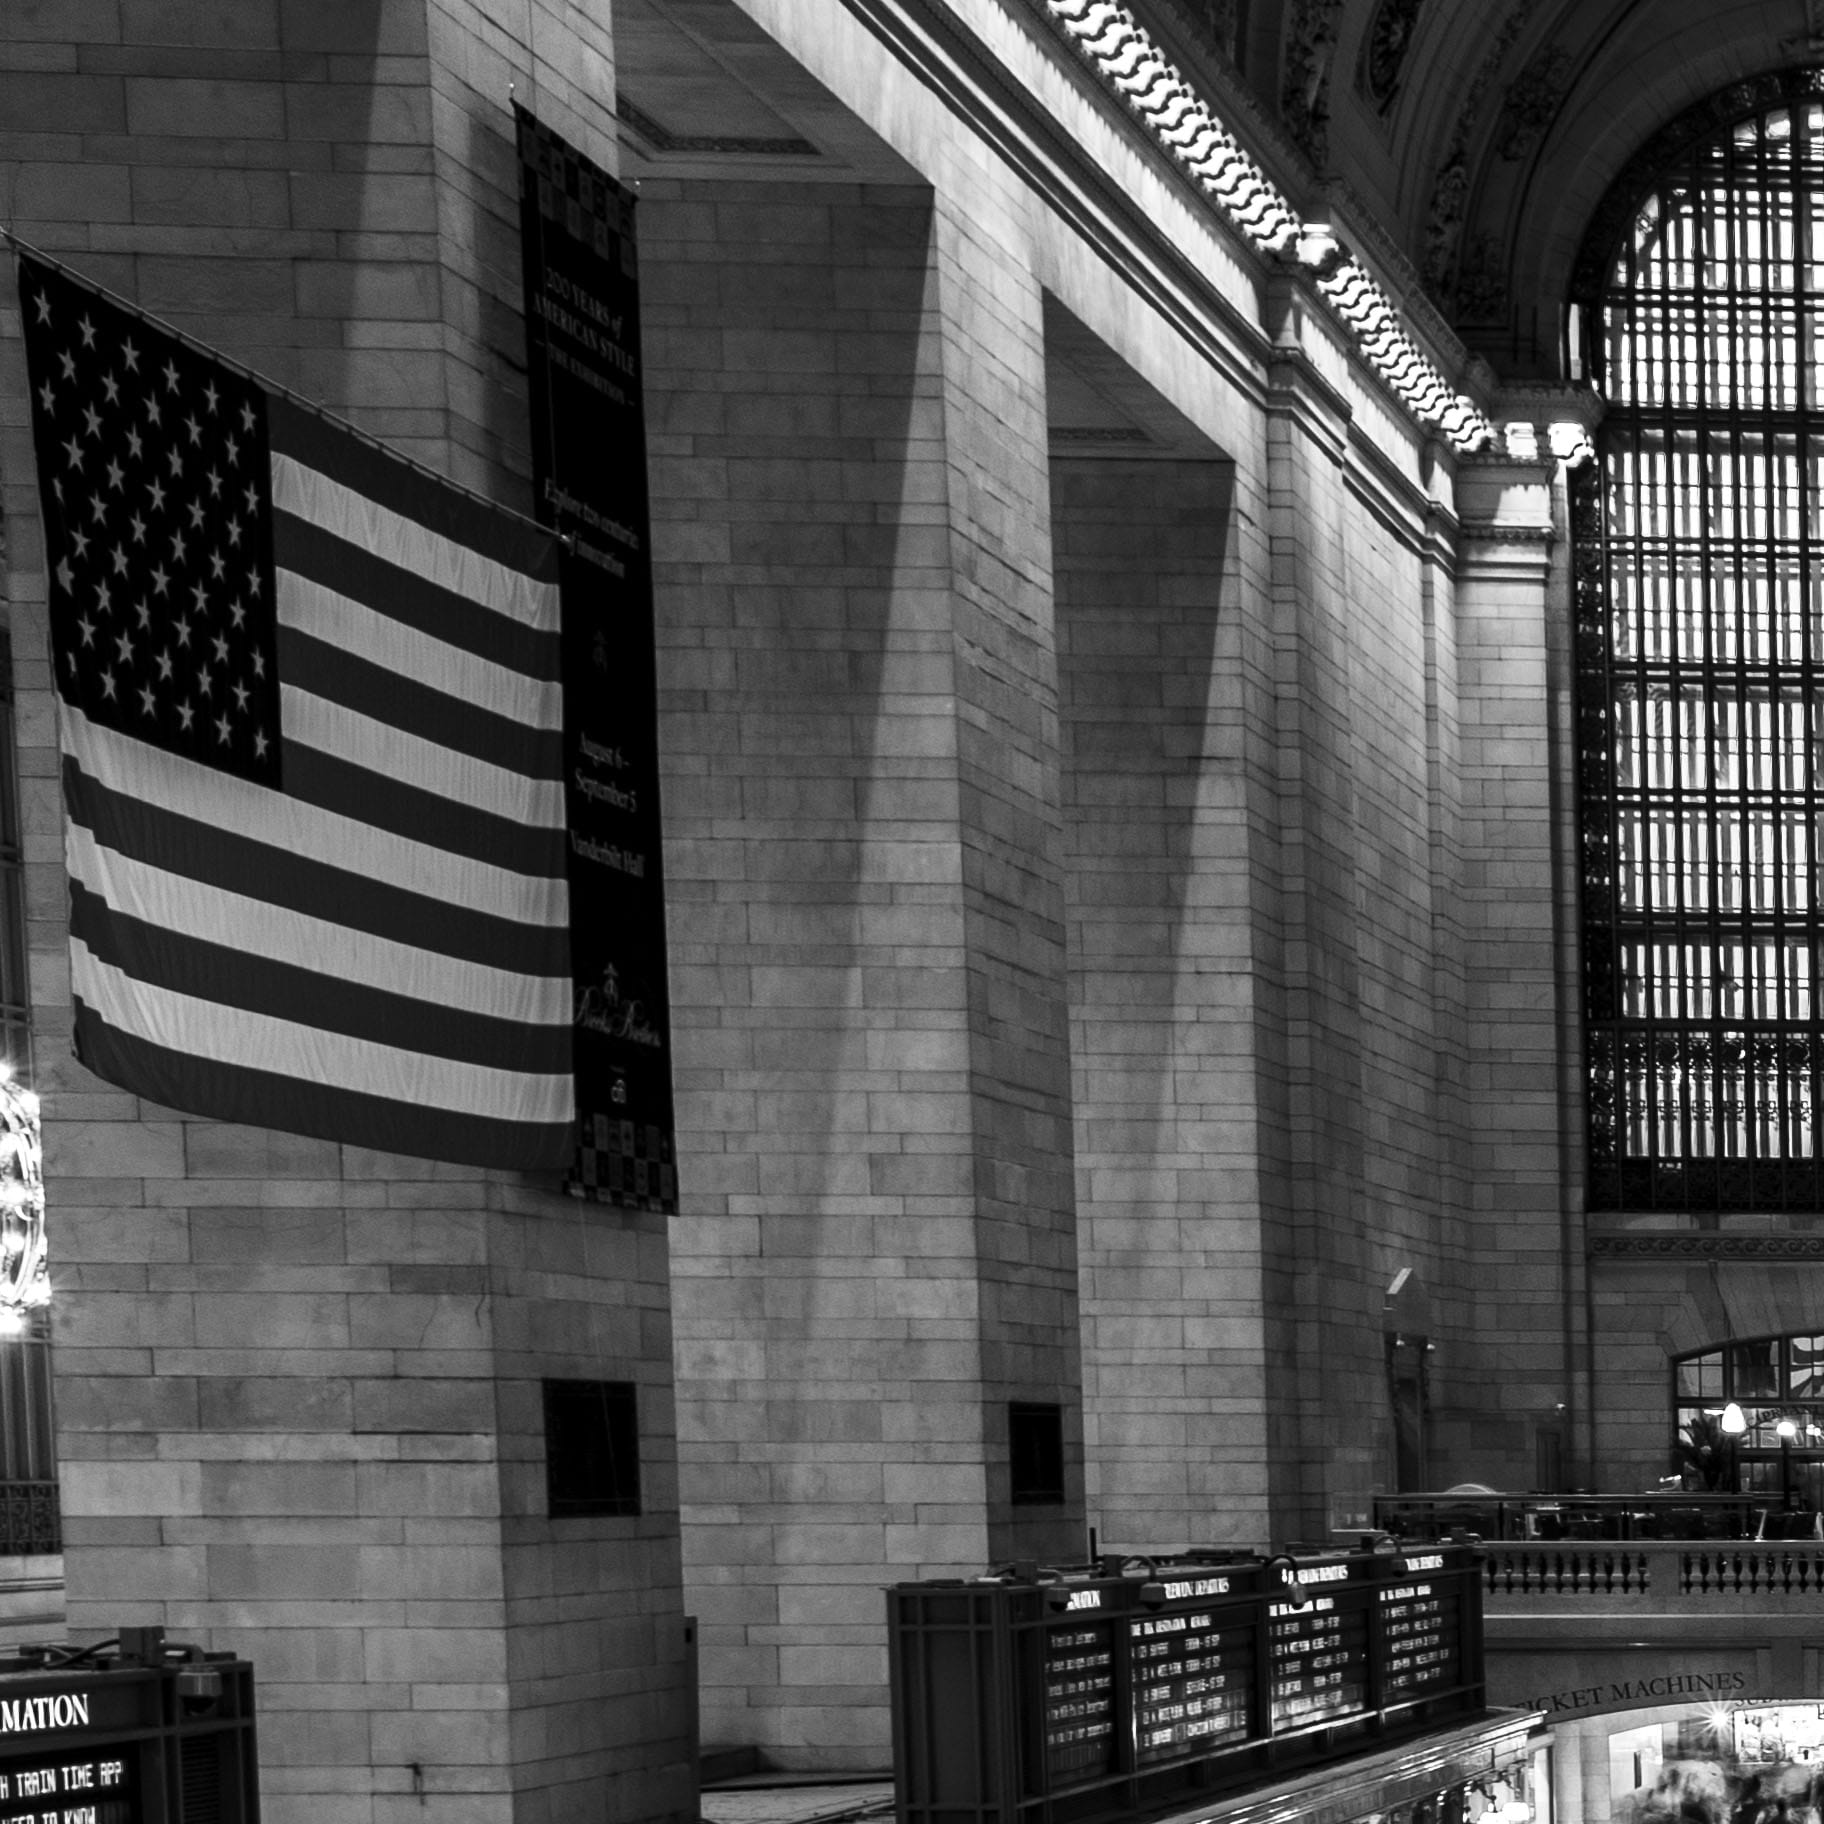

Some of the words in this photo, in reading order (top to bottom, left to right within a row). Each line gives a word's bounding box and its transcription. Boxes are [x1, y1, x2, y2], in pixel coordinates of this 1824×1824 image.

[1609, 1671, 1746, 1702] MACHINES
[0, 1693, 89, 1732] MATION
[15, 1768, 57, 1798] TRAIN
[61, 1763, 95, 1791] TIME
